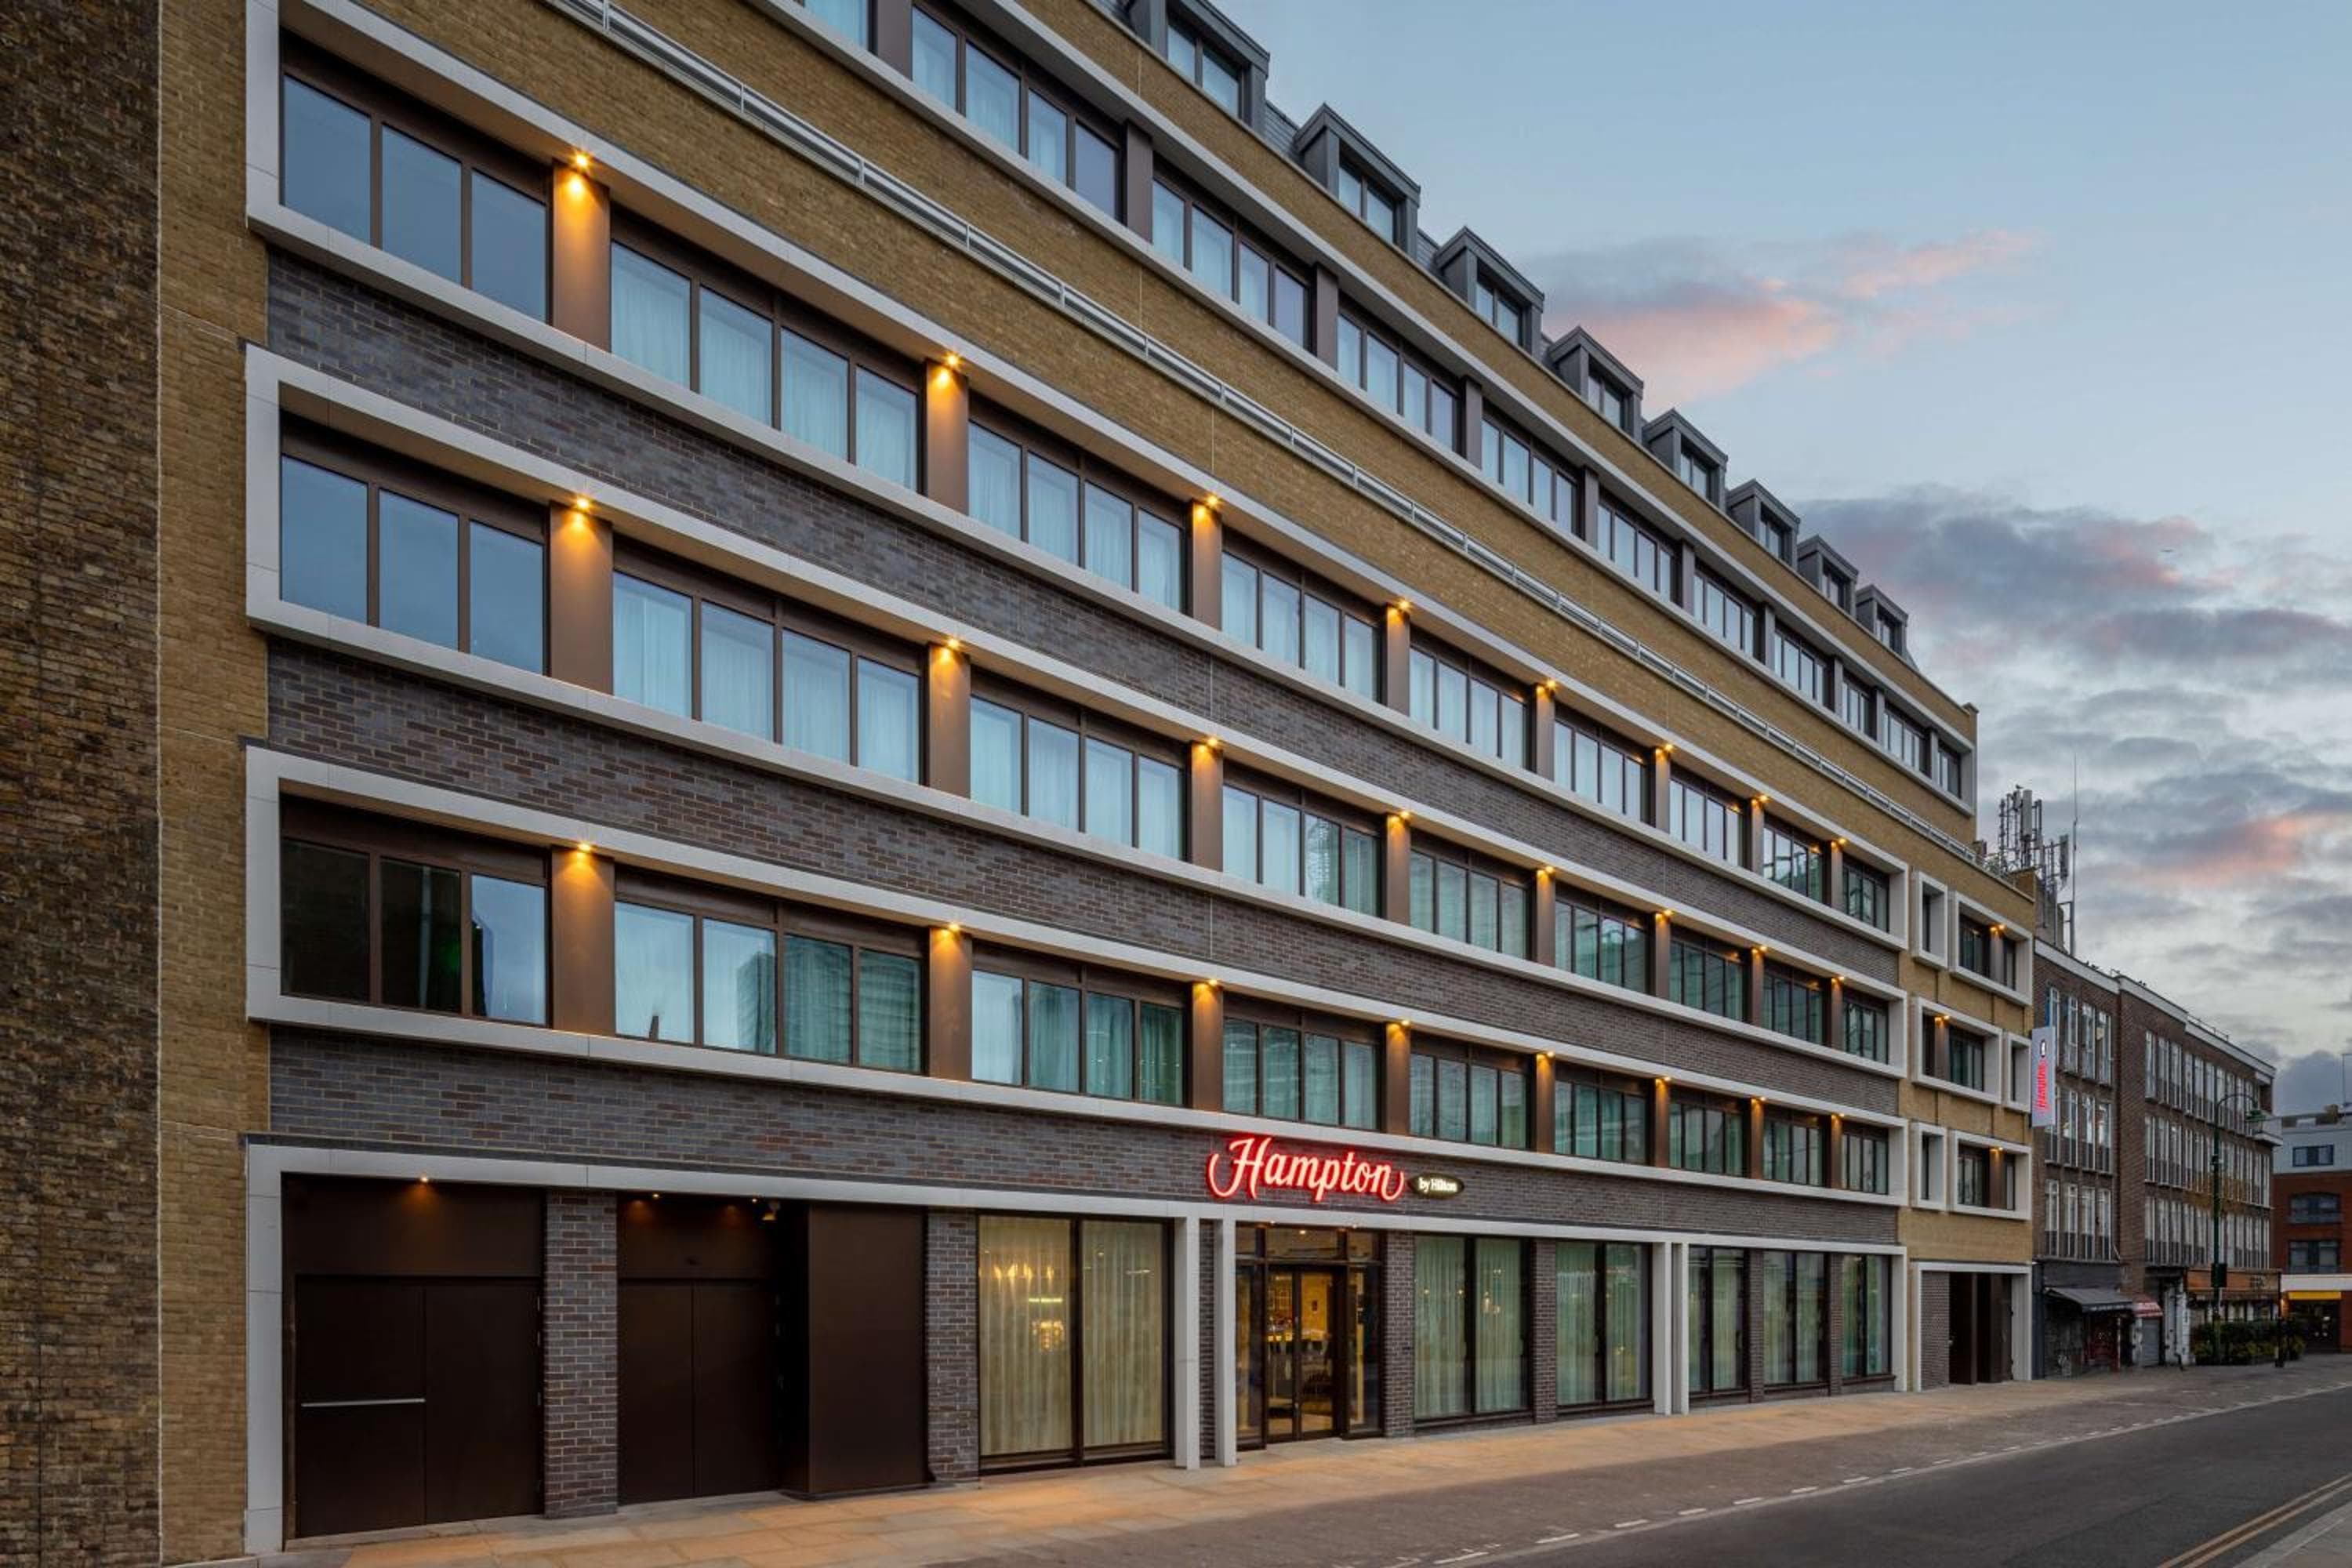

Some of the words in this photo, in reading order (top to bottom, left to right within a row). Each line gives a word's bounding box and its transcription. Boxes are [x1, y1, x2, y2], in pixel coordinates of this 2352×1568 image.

[1208, 1136, 1406, 1203] Hampton
[1418, 1177, 1430, 1193] by
[1431, 1178, 1457, 1192] Hilton
